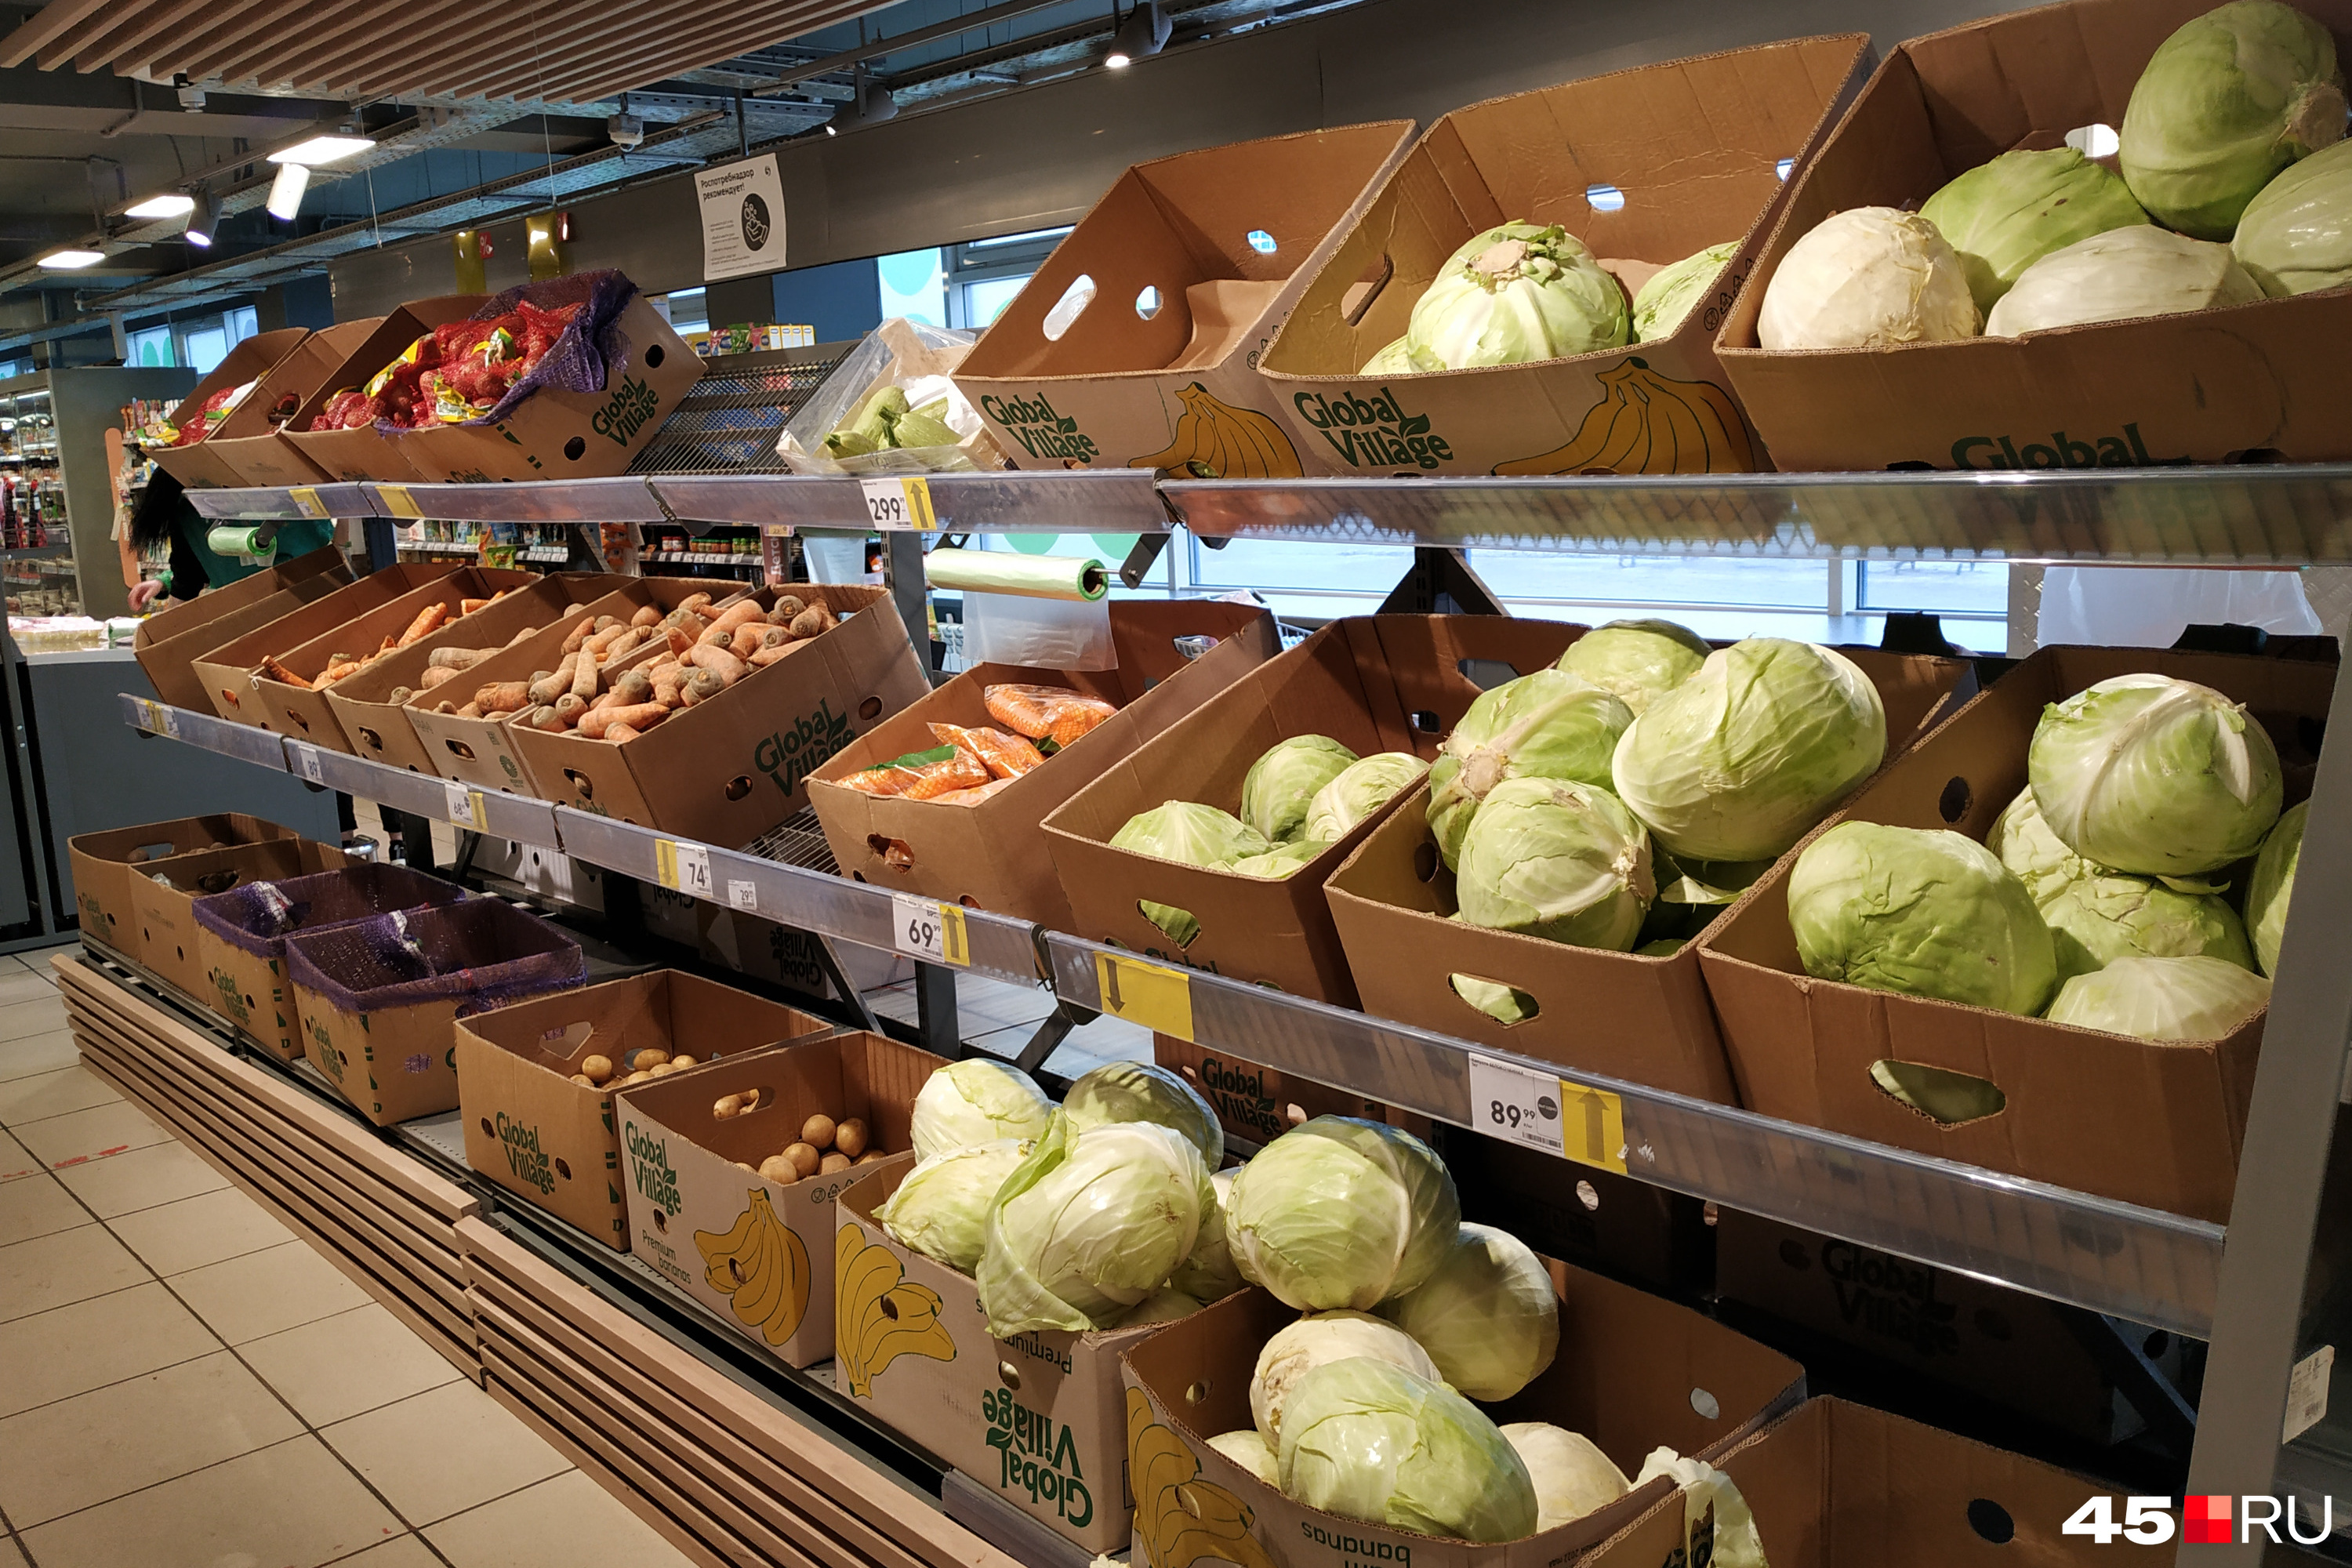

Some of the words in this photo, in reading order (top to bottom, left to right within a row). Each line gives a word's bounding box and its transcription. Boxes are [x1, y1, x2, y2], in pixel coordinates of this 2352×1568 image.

[701, 169, 754, 189] Роспотребнадзор
[702, 183, 746, 202] рекомендует!
[592, 373, 637, 435] Global
[607, 389, 659, 447] Village
[981, 391, 1058, 426] Global
[1294, 387, 1406, 429] Global
[1005, 426, 1100, 463] Village
[1319, 429, 1454, 470] Village
[1951, 422, 2151, 469] Global
[869, 497, 900, 521] 299
[754, 697, 833, 772] Global
[688, 862, 706, 887] 74
[909, 919, 933, 948] 69
[1202, 1058, 1264, 1098] Global
[496, 1111, 539, 1154] Global
[1210, 1088, 1283, 1136] Village
[1491, 1100, 1521, 1128] 89
[1523, 1109, 1535, 1120] 99
[626, 1120, 668, 1168] Global
[503, 1142, 556, 1196] Village
[631, 1155, 683, 1216] Village
[642, 1229, 677, 1261] Premium
[658, 1252, 692, 1285] bananas
[1003, 1334, 1073, 1375] Premium
[982, 1388, 1084, 1480] Village
[1001, 1449, 1094, 1528] Global
[1301, 1521, 1411, 1568] bananas
